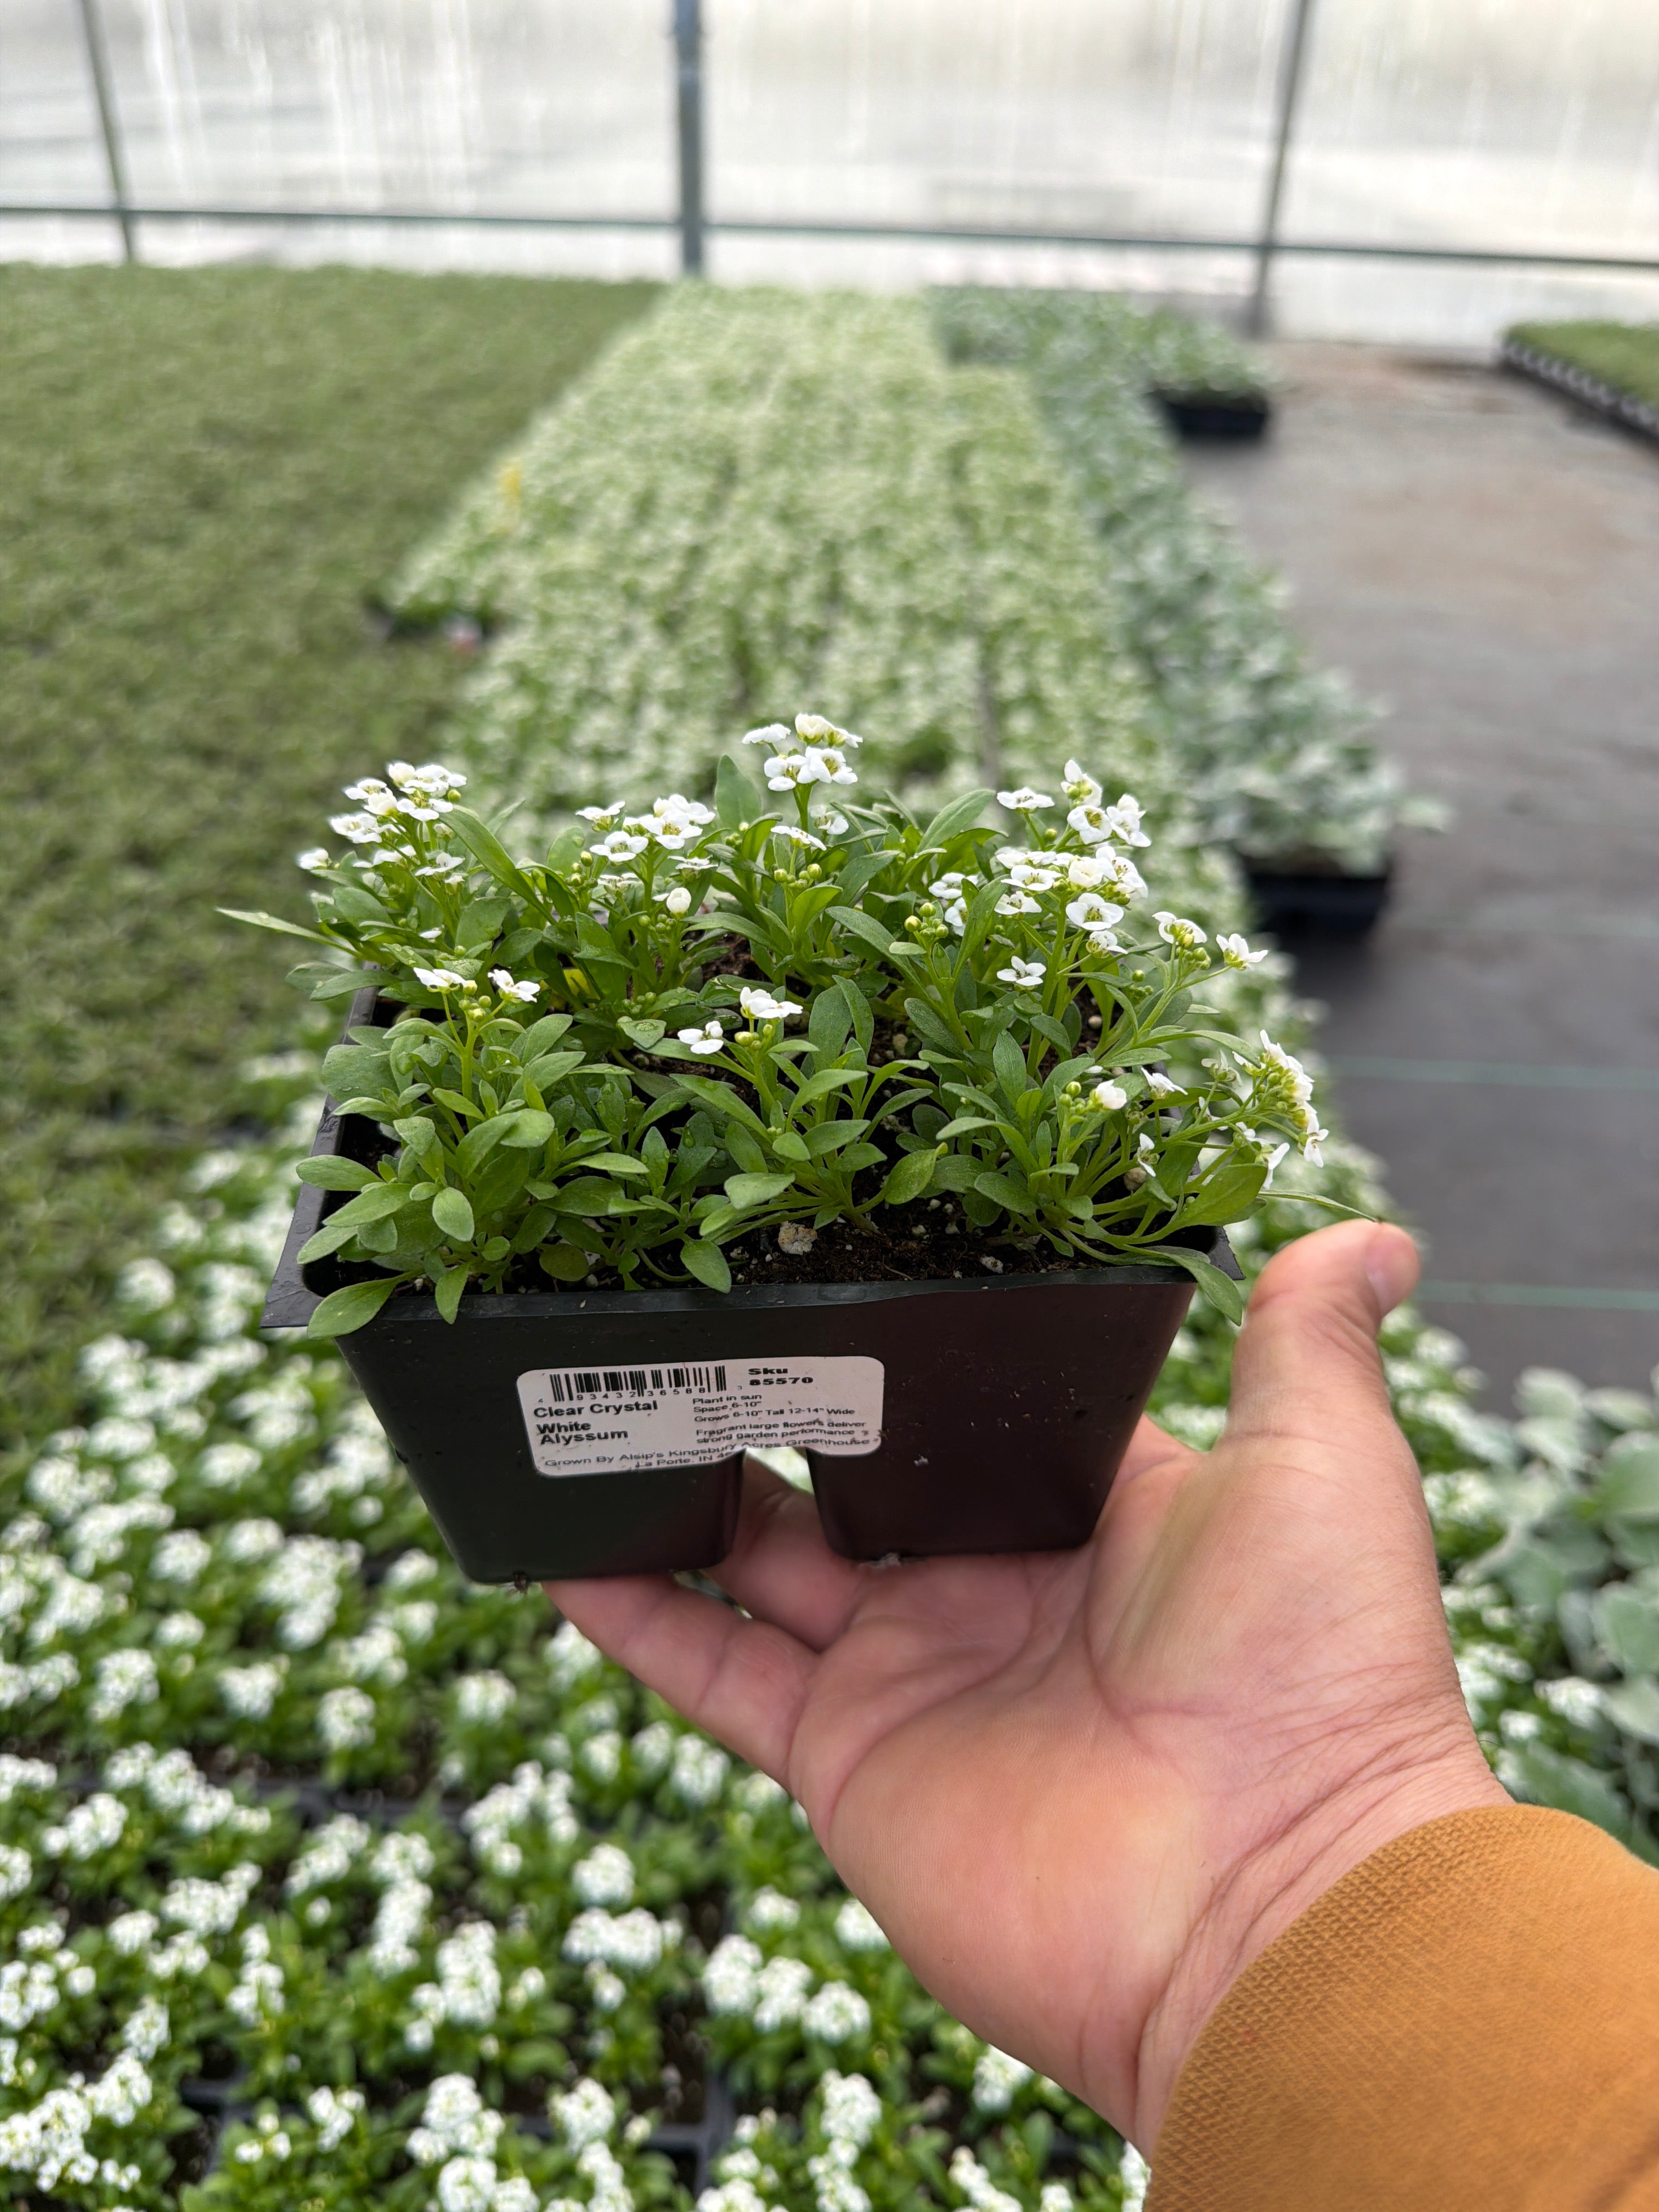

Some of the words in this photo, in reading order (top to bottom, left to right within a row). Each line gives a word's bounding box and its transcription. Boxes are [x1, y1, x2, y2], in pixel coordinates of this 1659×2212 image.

[749, 1376, 814, 1385] 85570
[692, 1396, 723, 1404] Plant
[533, 1406, 585, 1418] Clear
[589, 1400, 658, 1415] Crystal
[694, 1414, 730, 1422] Grows
[536, 1421, 592, 1434] White
[696, 1424, 747, 1436] Fragrant
[540, 1430, 629, 1446] Alyssum
[696, 1434, 733, 1443] strong
[736, 1430, 778, 1439] garden
[781, 1427, 855, 1437] performance
[545, 1458, 591, 1466] Grown
[619, 1452, 664, 1460] Alsip's
[669, 1443, 737, 1457] Kingsbury
